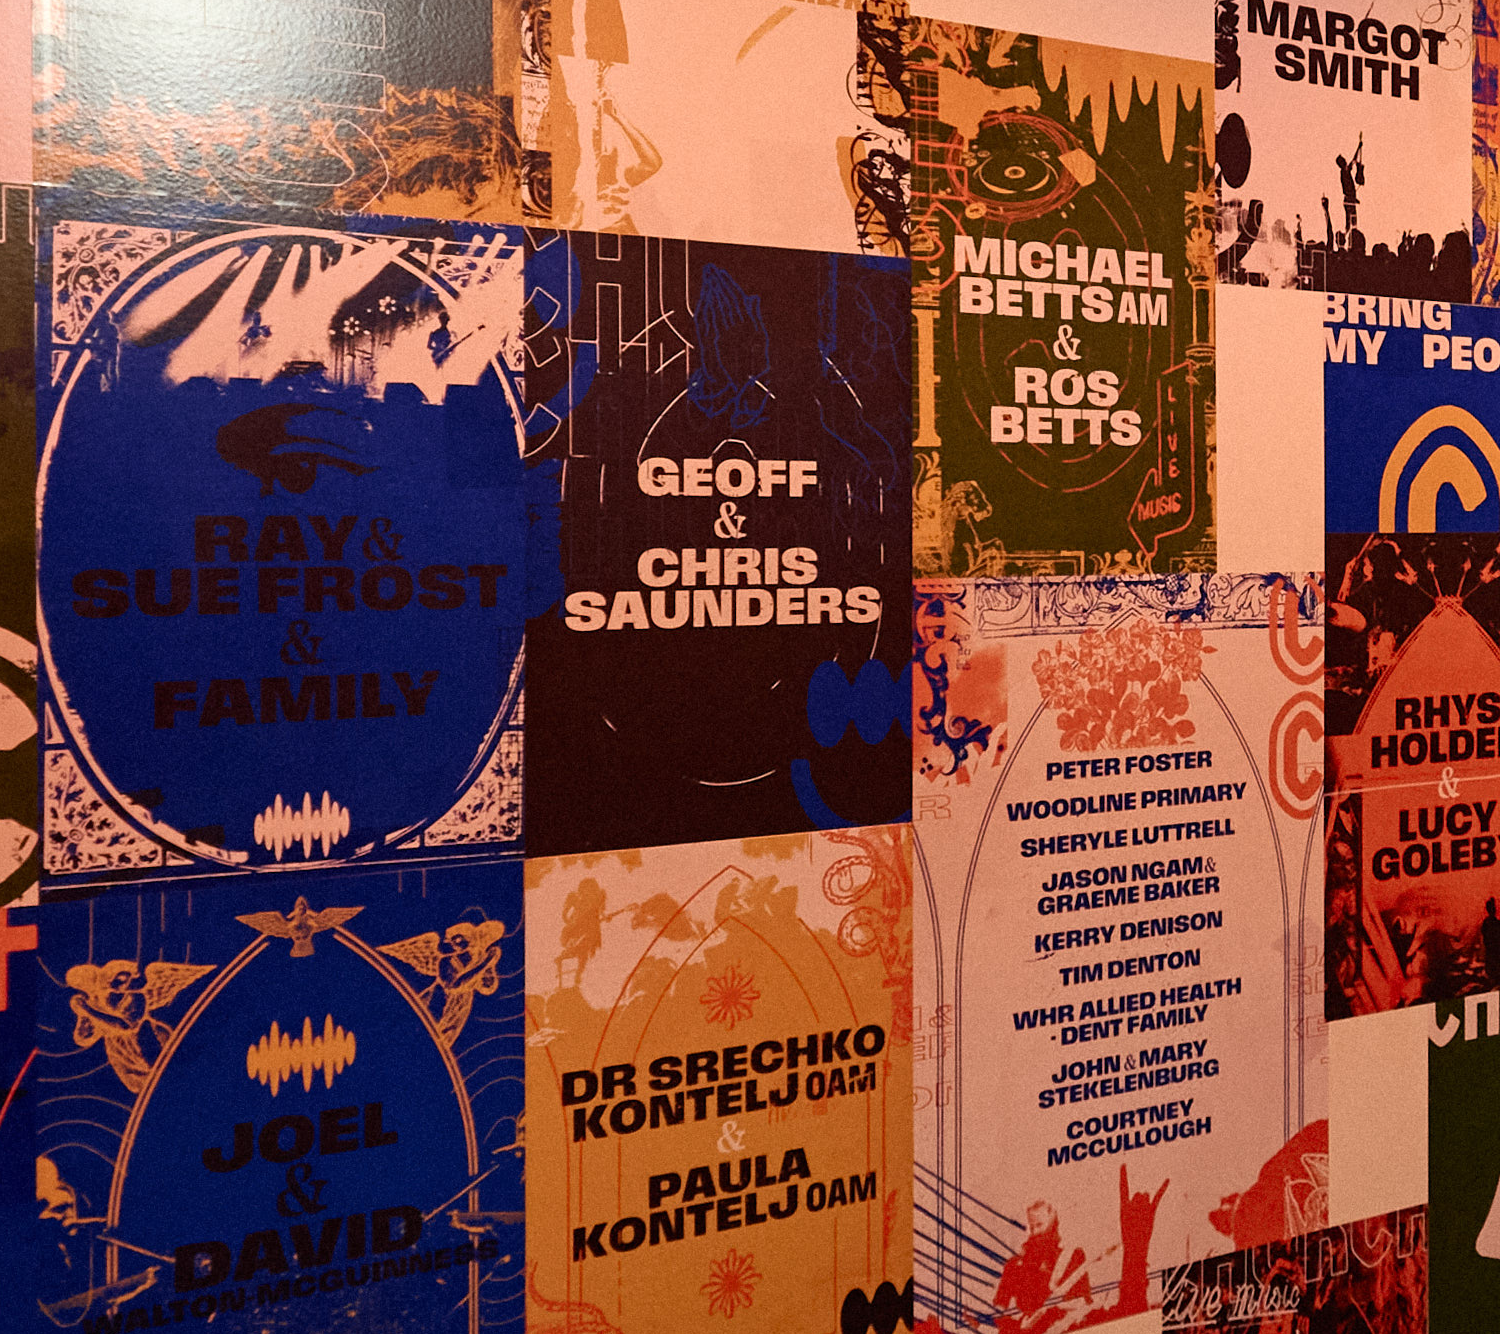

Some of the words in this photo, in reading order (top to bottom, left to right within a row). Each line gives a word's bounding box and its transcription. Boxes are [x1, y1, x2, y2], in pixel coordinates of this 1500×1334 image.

[1275, 43, 1420, 101] SMITH
[954, 235, 1172, 288] MICHAEL
[959, 276, 1114, 324] BETTS
[1118, 292, 1168, 326] AM
[1053, 325, 1081, 361] &
[1323, 327, 1387, 365] MY
[1014, 366, 1120, 406] ROS
[990, 406, 1142, 446] BETTS
[638, 457, 818, 498] GEOFF
[195, 515, 358, 563] RAY
[363, 517, 402, 560] &
[715, 502, 746, 540] &
[638, 547, 818, 587] CHRIS
[72, 568, 240, 618] SUE
[258, 565, 508, 614] FROST
[565, 586, 882, 632] SAUNDERS
[281, 620, 325, 665] &
[154, 671, 438, 730] FAMILY
[1395, 691, 1500, 730] RHYS
[1047, 754, 1120, 780] PETER
[1125, 751, 1212, 773] FOSTER
[1007, 794, 1137, 822] WOODLINE
[1141, 782, 1247, 809] PRIMARY
[1399, 800, 1497, 843] LUCY
[1021, 830, 1128, 857] SHERYLE
[1131, 819, 1235, 845] LUTTRELL
[1038, 888, 1139, 915] GRAEME
[1144, 877, 1220, 902] BAKER
[1042, 866, 1127, 892] JASON
[1131, 857, 1202, 882] NGAM
[1034, 927, 1115, 953] KERRY
[1120, 911, 1223, 941] DENISON
[1060, 964, 1103, 986] TIM
[1108, 949, 1201, 979] DENTON
[1013, 1005, 1074, 1030] WHR
[1079, 992, 1155, 1022] ALLIED
[1160, 978, 1242, 1005] HEALTH
[562, 1063, 637, 1107] DR
[649, 1025, 885, 1093] SRECHKO
[1052, 1055, 1120, 1083] JOHN
[1140, 1040, 1208, 1066] MARY
[573, 1072, 799, 1143] KONTELJ
[805, 1061, 877, 1100] OAM
[1038, 1059, 1220, 1109] STEKELENBURG
[200, 1102, 398, 1173] JOEL
[1067, 1099, 1194, 1140] COURTNEY
[1047, 1116, 1212, 1167] MCCULLOUGH
[648, 1148, 811, 1209] PAULA
[573, 1189, 799, 1262] KONTELJ
[806, 1171, 878, 1212] OAM
[173, 1204, 423, 1296] DAVID
[1233, 1283, 1301, 1318] music
